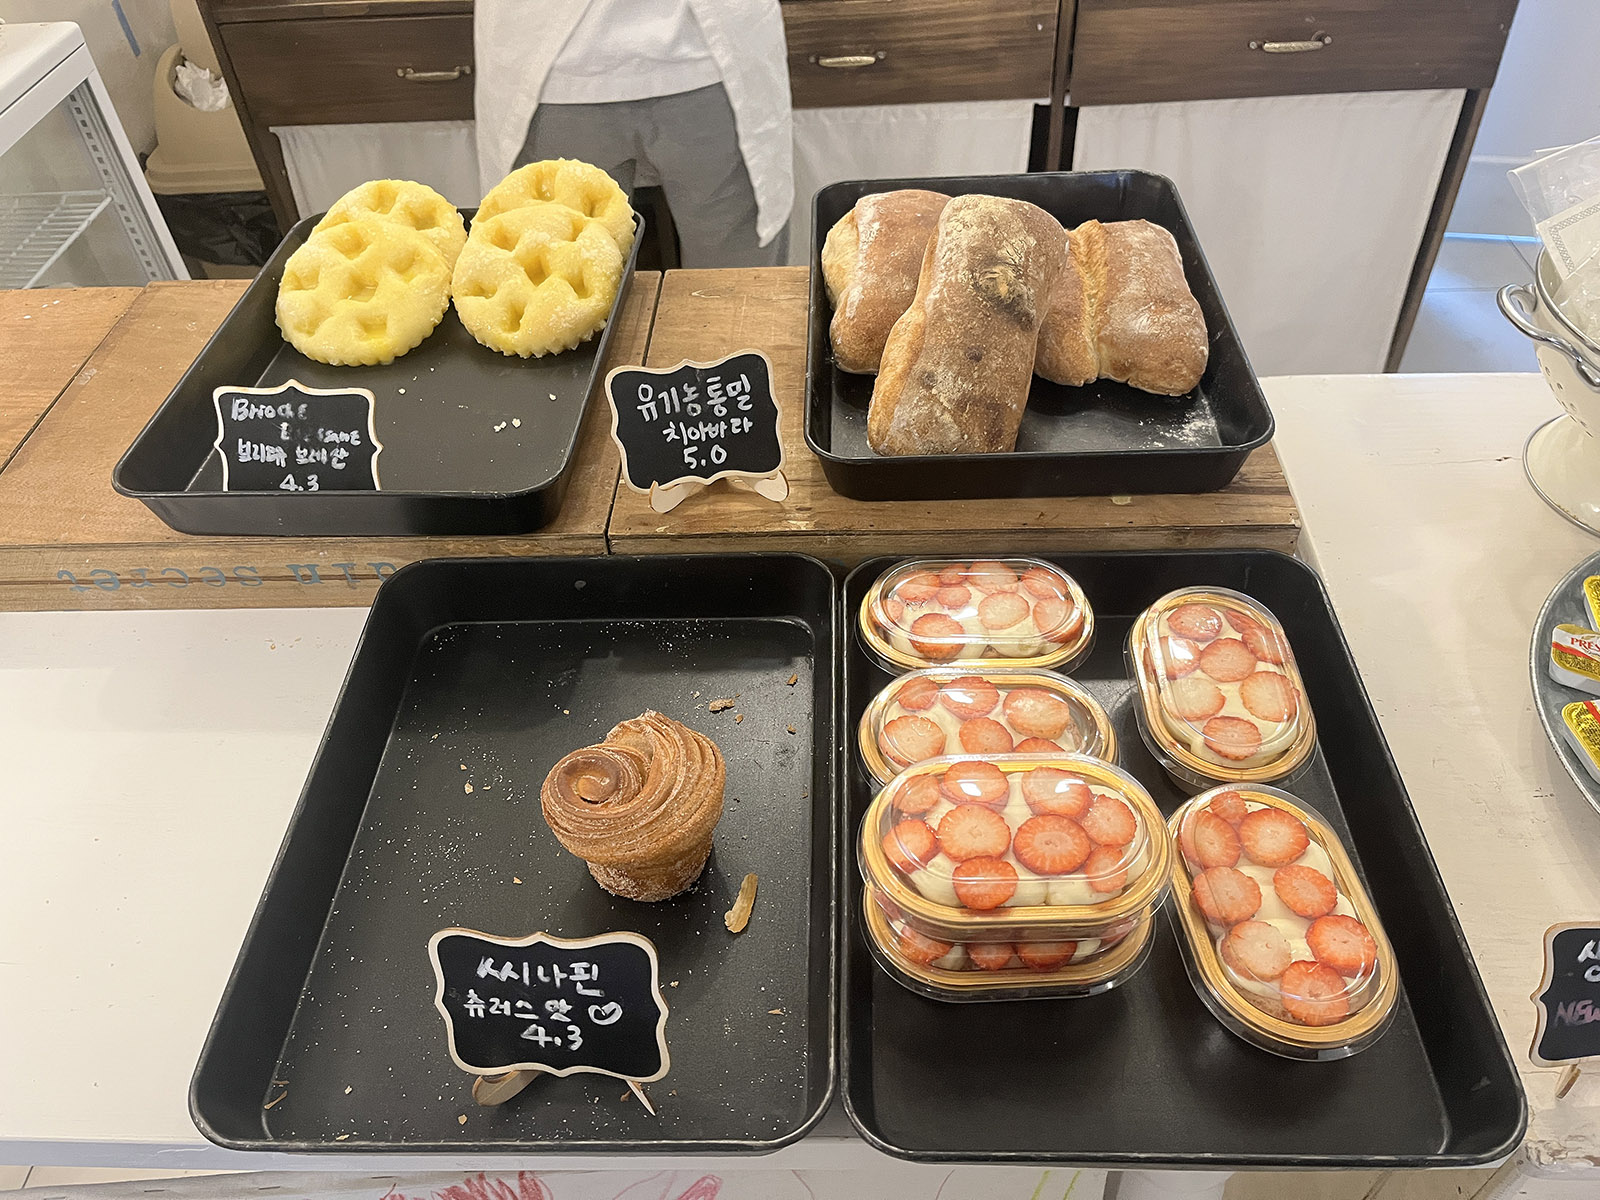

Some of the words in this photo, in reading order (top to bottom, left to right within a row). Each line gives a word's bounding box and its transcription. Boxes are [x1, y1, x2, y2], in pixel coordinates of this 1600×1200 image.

[637, 382, 702, 422] 유기농
[706, 373, 753, 417] 통밀
[683, 444, 728, 469] 5.0
[279, 473, 320, 492] 4.3
[57, 565, 264, 592] secret
[520, 1023, 584, 1051] 4.3
